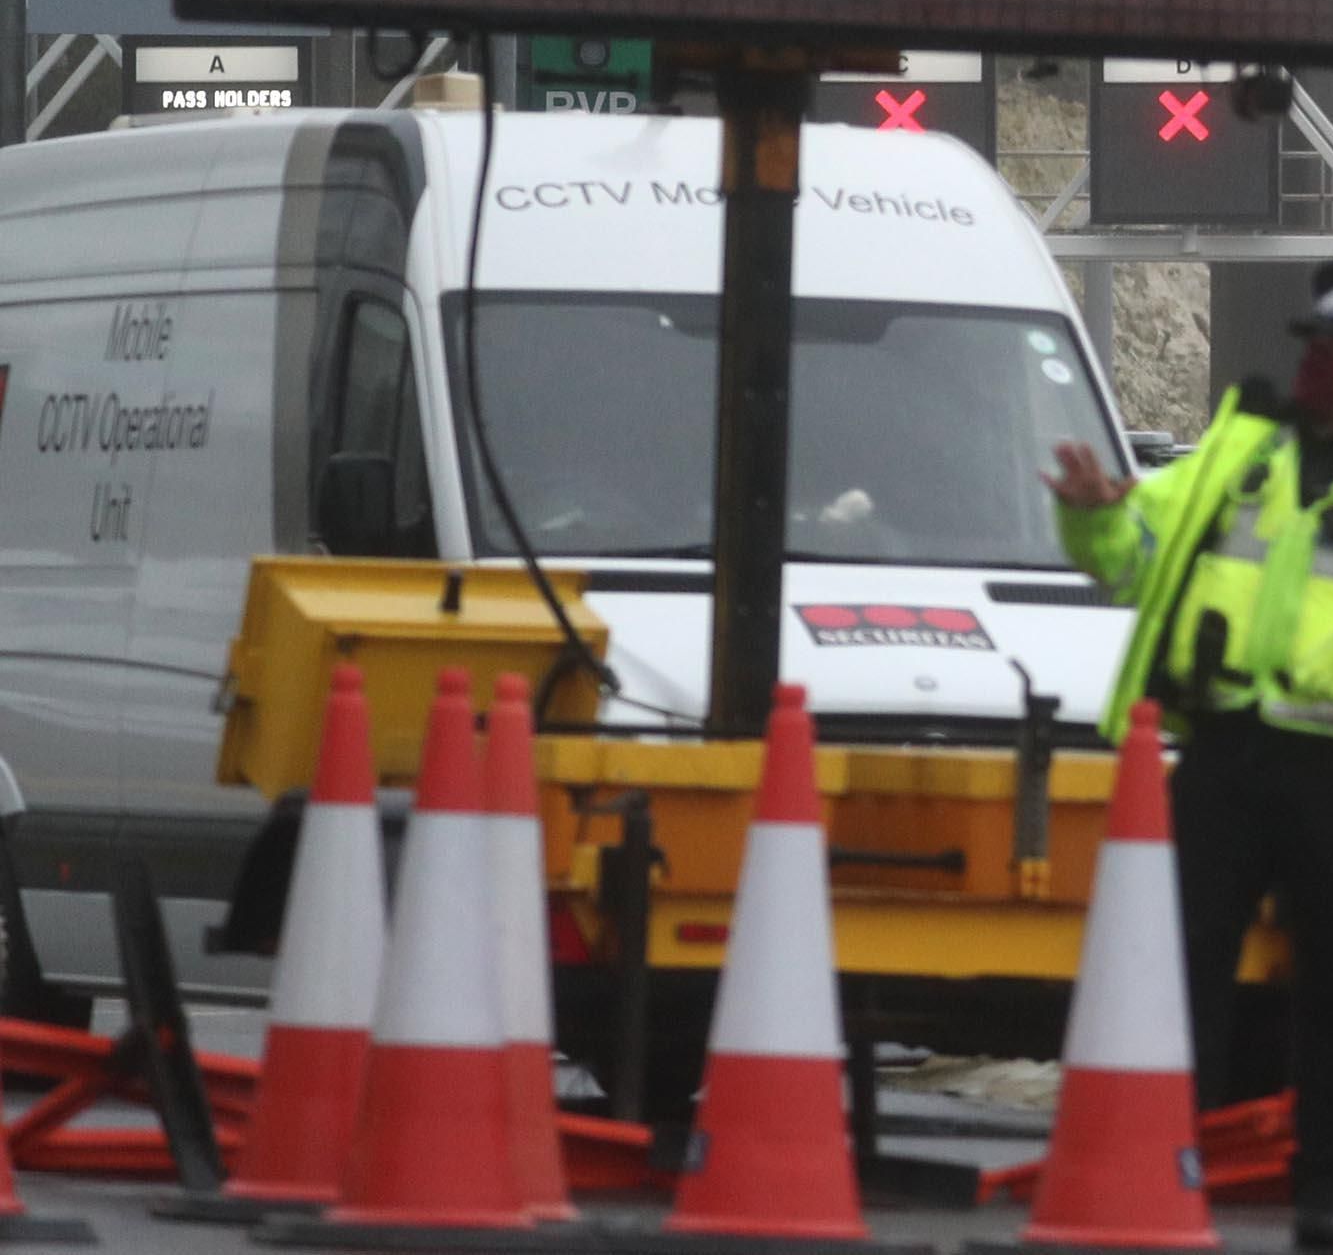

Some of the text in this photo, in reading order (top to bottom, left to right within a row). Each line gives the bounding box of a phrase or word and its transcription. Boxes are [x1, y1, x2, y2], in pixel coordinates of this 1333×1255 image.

[209, 55, 225, 74] A
[1176, 58, 1191, 74] D
[162, 89, 292, 109] PASS HOLDERS
[495, 181, 632, 211] CCTV
[812, 186, 976, 227] Vehicle
[104, 303, 172, 361] Mobile
[38, 388, 215, 465] CCTV Operational
[91, 483, 132, 542] Unit
[818, 629, 990, 649] SECURITAS
